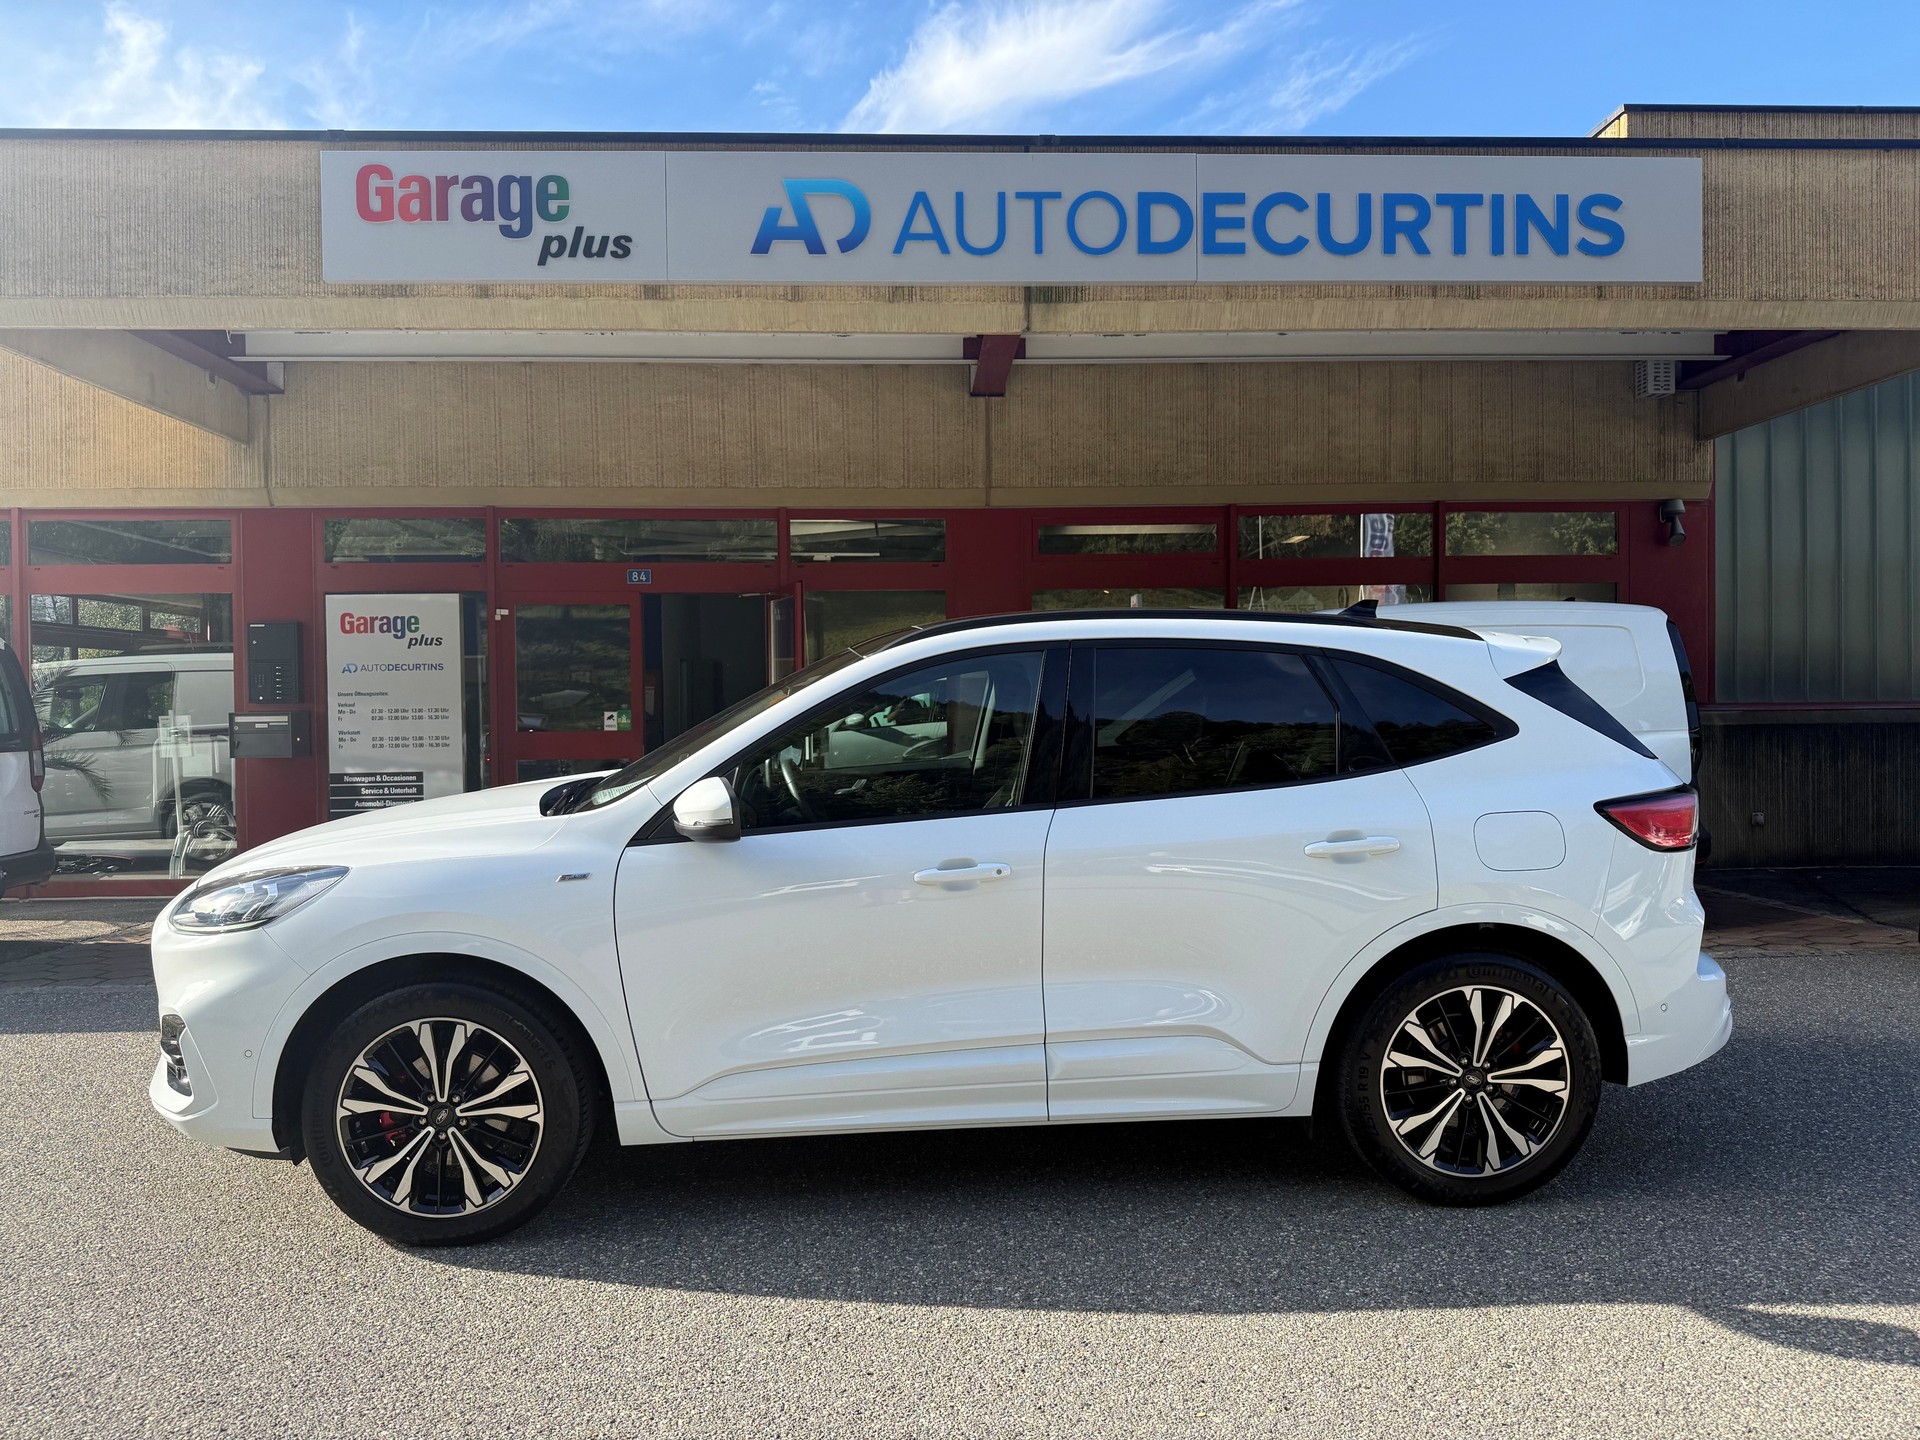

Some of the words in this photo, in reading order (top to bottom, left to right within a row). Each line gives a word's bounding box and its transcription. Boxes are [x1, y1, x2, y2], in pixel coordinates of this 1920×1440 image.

[355, 164, 570, 239] Garage
[892, 190, 1625, 257] AUTODECURTINS
[537, 226, 633, 266] plus
[632, 571, 647, 582] 84
[340, 613, 420, 640] Garage
[407, 634, 444, 650] plus
[360, 663, 444, 672] AUTODECURTINS
